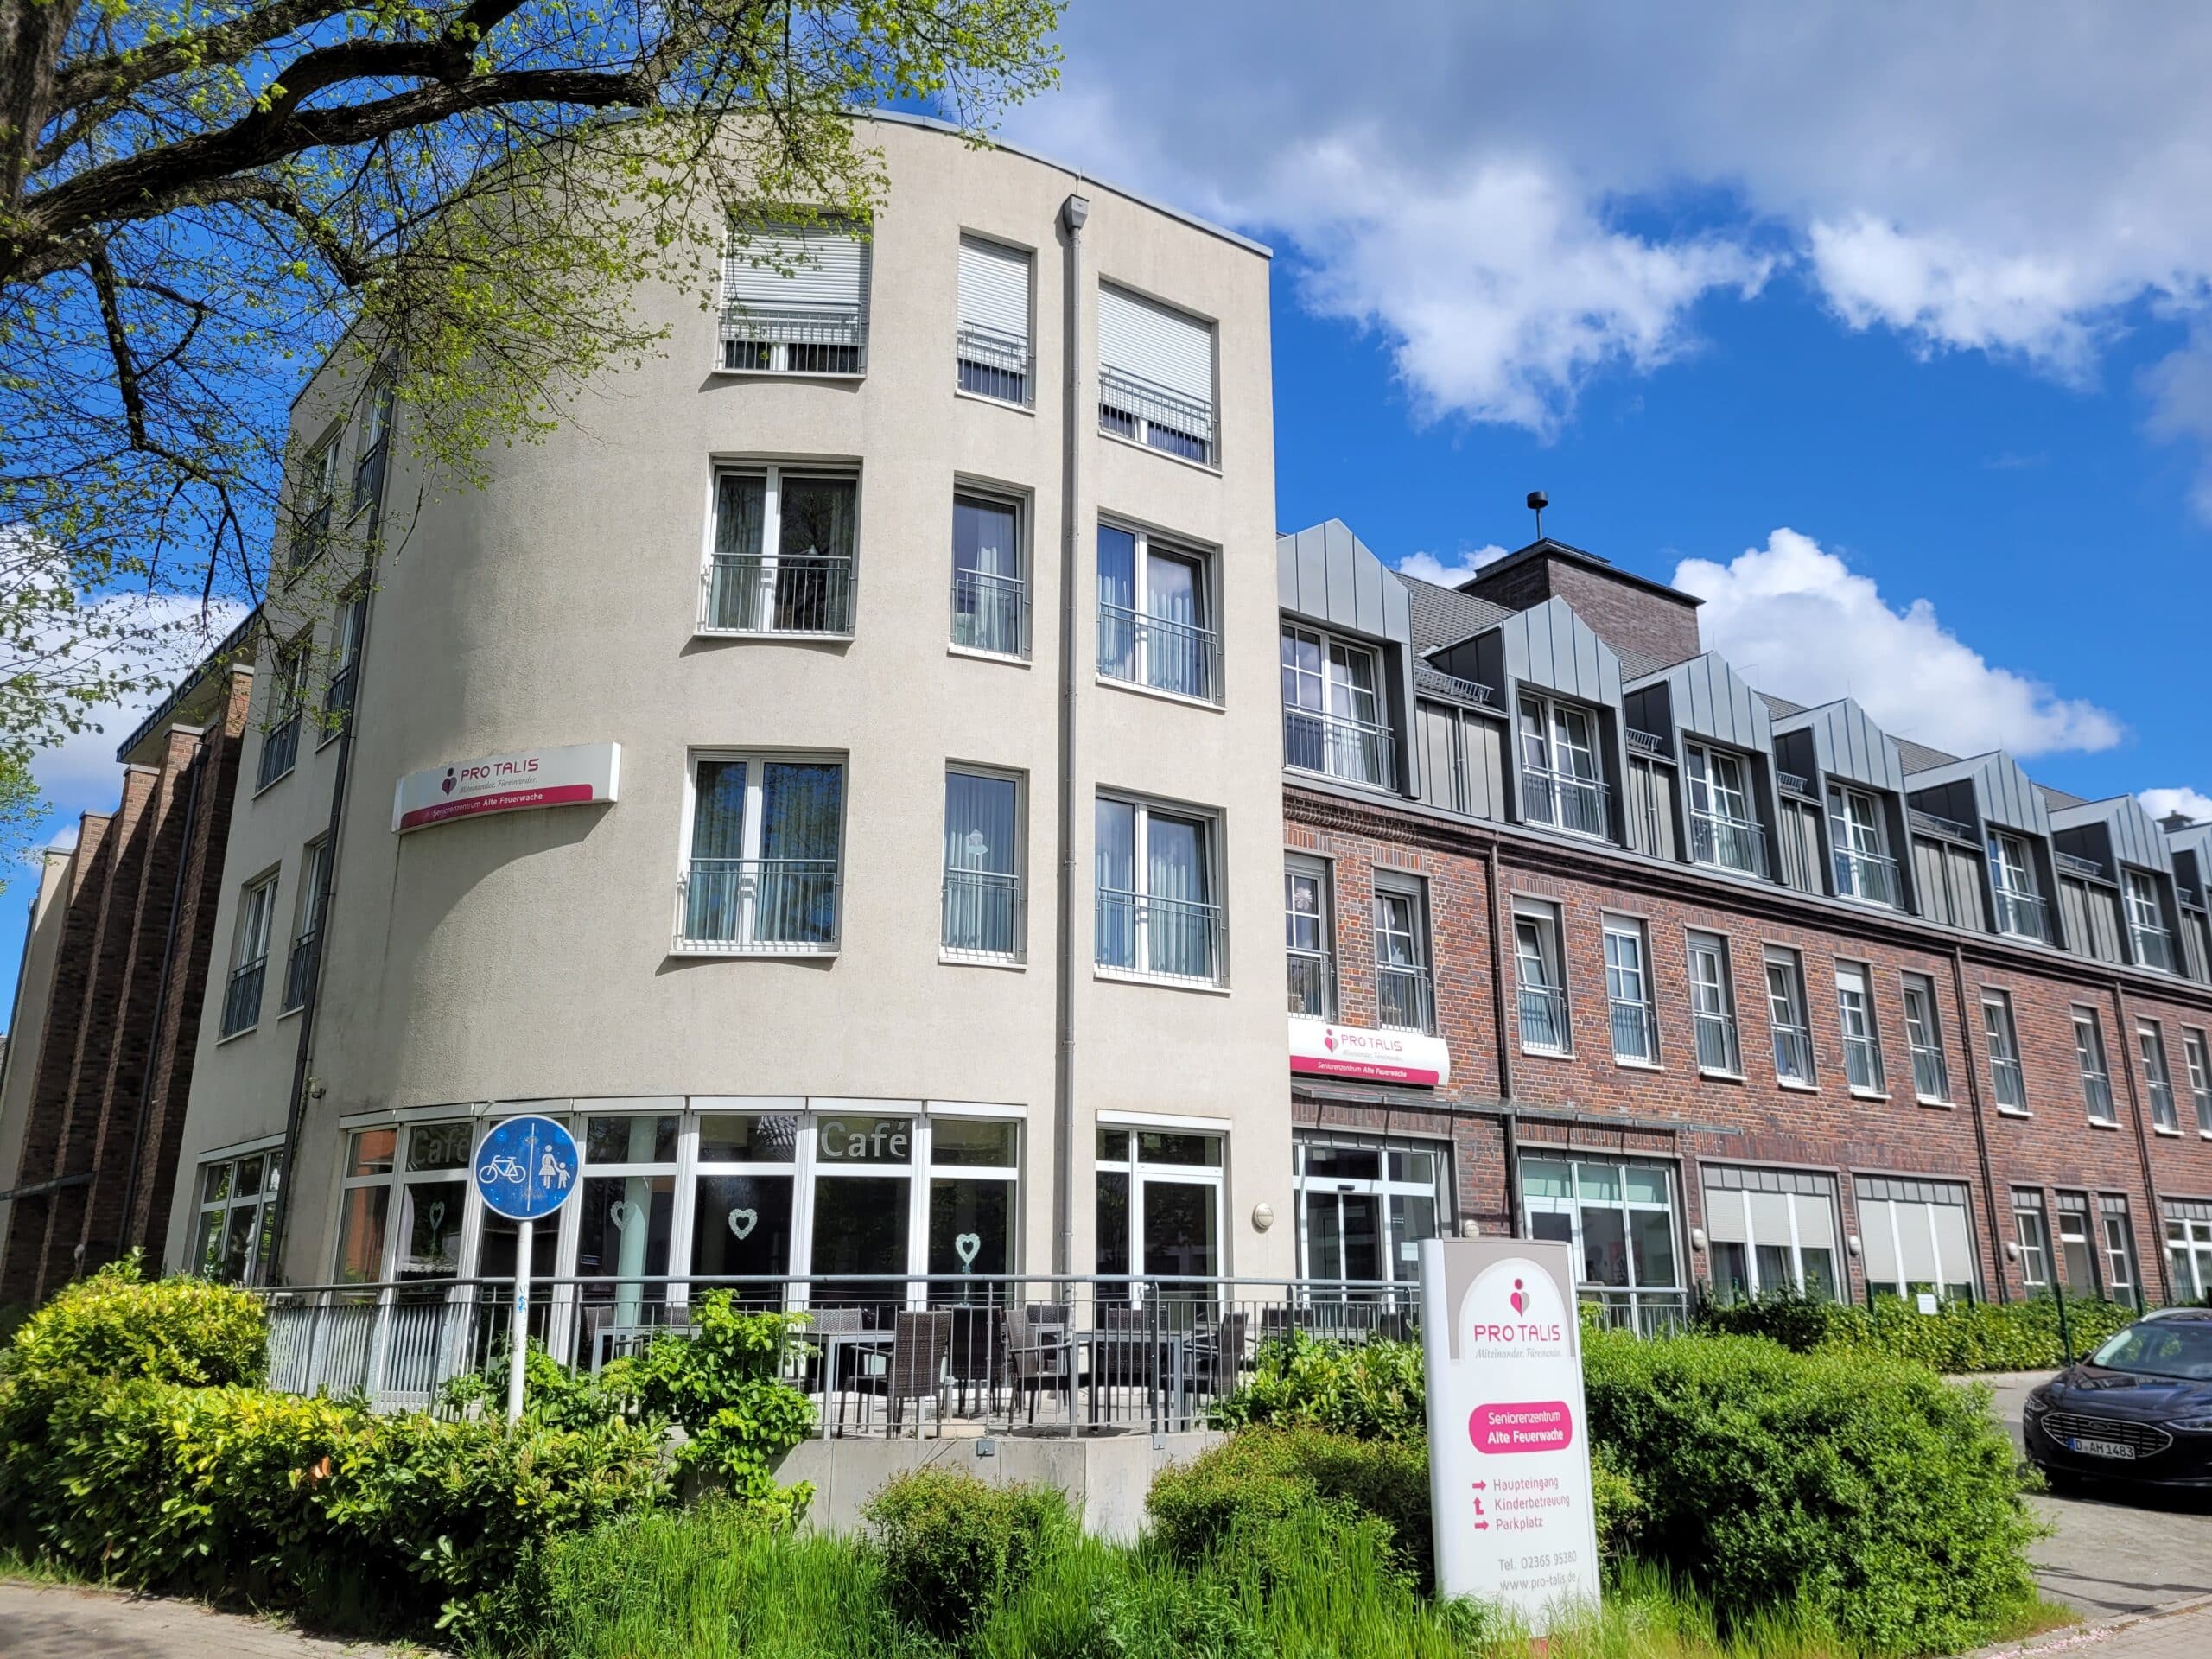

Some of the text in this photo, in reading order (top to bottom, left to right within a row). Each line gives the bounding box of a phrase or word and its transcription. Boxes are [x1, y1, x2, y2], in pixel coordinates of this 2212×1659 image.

[461, 758, 539, 782] PRO TALIS
[433, 792, 543, 817] Seniorenzentrum Alte Feuerwache
[1341, 1034, 1402, 1052] PRO TALIS
[1318, 1061, 1407, 1077] Seniorenzentrum Alte Feuerwache
[821, 1121, 908, 1157] Café
[1474, 1324, 1560, 1342] PRO TALIS
[1475, 1347, 1525, 1359] Miteinander.
[1488, 1411, 1560, 1425] Seniorenzentrum
[1488, 1427, 1564, 1444] Alte Feuerwache
[2075, 1440, 2133, 1458] D AH 1483
[1493, 1477, 1559, 1493] Haupteingang
[1495, 1495, 1570, 1510] Kinderbetreuung
[1496, 1516, 1543, 1532] Parkplatz
[1497, 1550, 1577, 1571] Tel. 02365 95380
[1500, 1570, 1576, 1591] www.pro-talis.de
